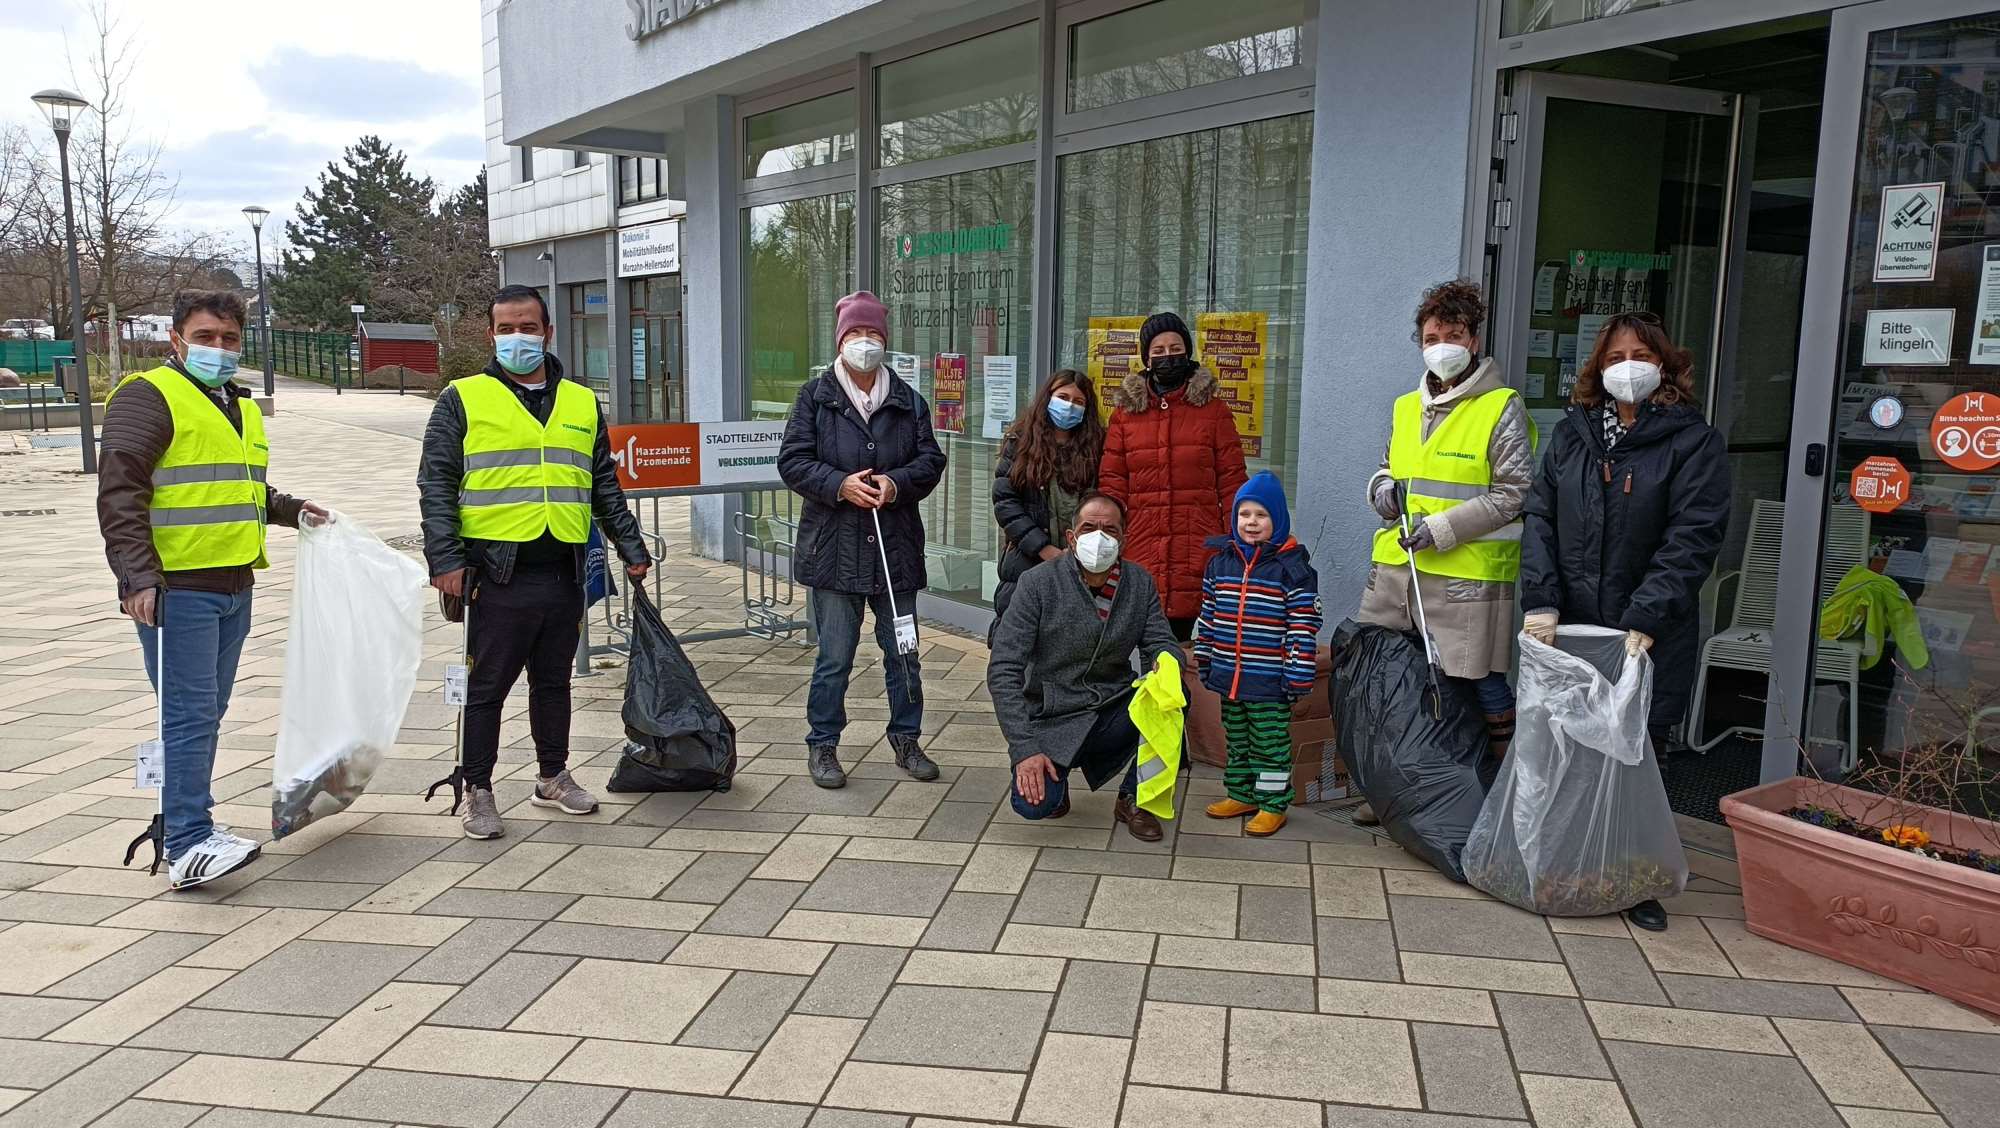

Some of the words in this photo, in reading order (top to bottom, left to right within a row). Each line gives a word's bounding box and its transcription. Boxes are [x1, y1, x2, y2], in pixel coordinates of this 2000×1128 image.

[623, 232, 644, 243] Diakonie
[623, 243, 674, 258] Mobilitätshilfedienst
[1882, 241, 1932, 251] ACHTUNG
[623, 258, 673, 272] Marzahn-Hellersdorf
[1880, 263, 1930, 271] überwachung!
[894, 265, 1013, 294] Stadtteilzentrum
[1881, 322, 1912, 334] Bitte
[1208, 331, 1219, 340] Für
[1234, 333, 1252, 342] Stadt
[1218, 345, 1258, 354] bezahlbaren
[1880, 337, 1934, 352] klingeln
[1218, 357, 1240, 366] Mieten
[1221, 370, 1231, 379] für
[1562, 374, 1577, 384] Mo
[935, 379, 965, 391] MACHEN?
[1959, 414, 1995, 422] beachten
[706, 432, 783, 444] STADTTEILZENTR
[636, 445, 691, 456] Marzahner
[636, 456, 691, 466] Promenade
